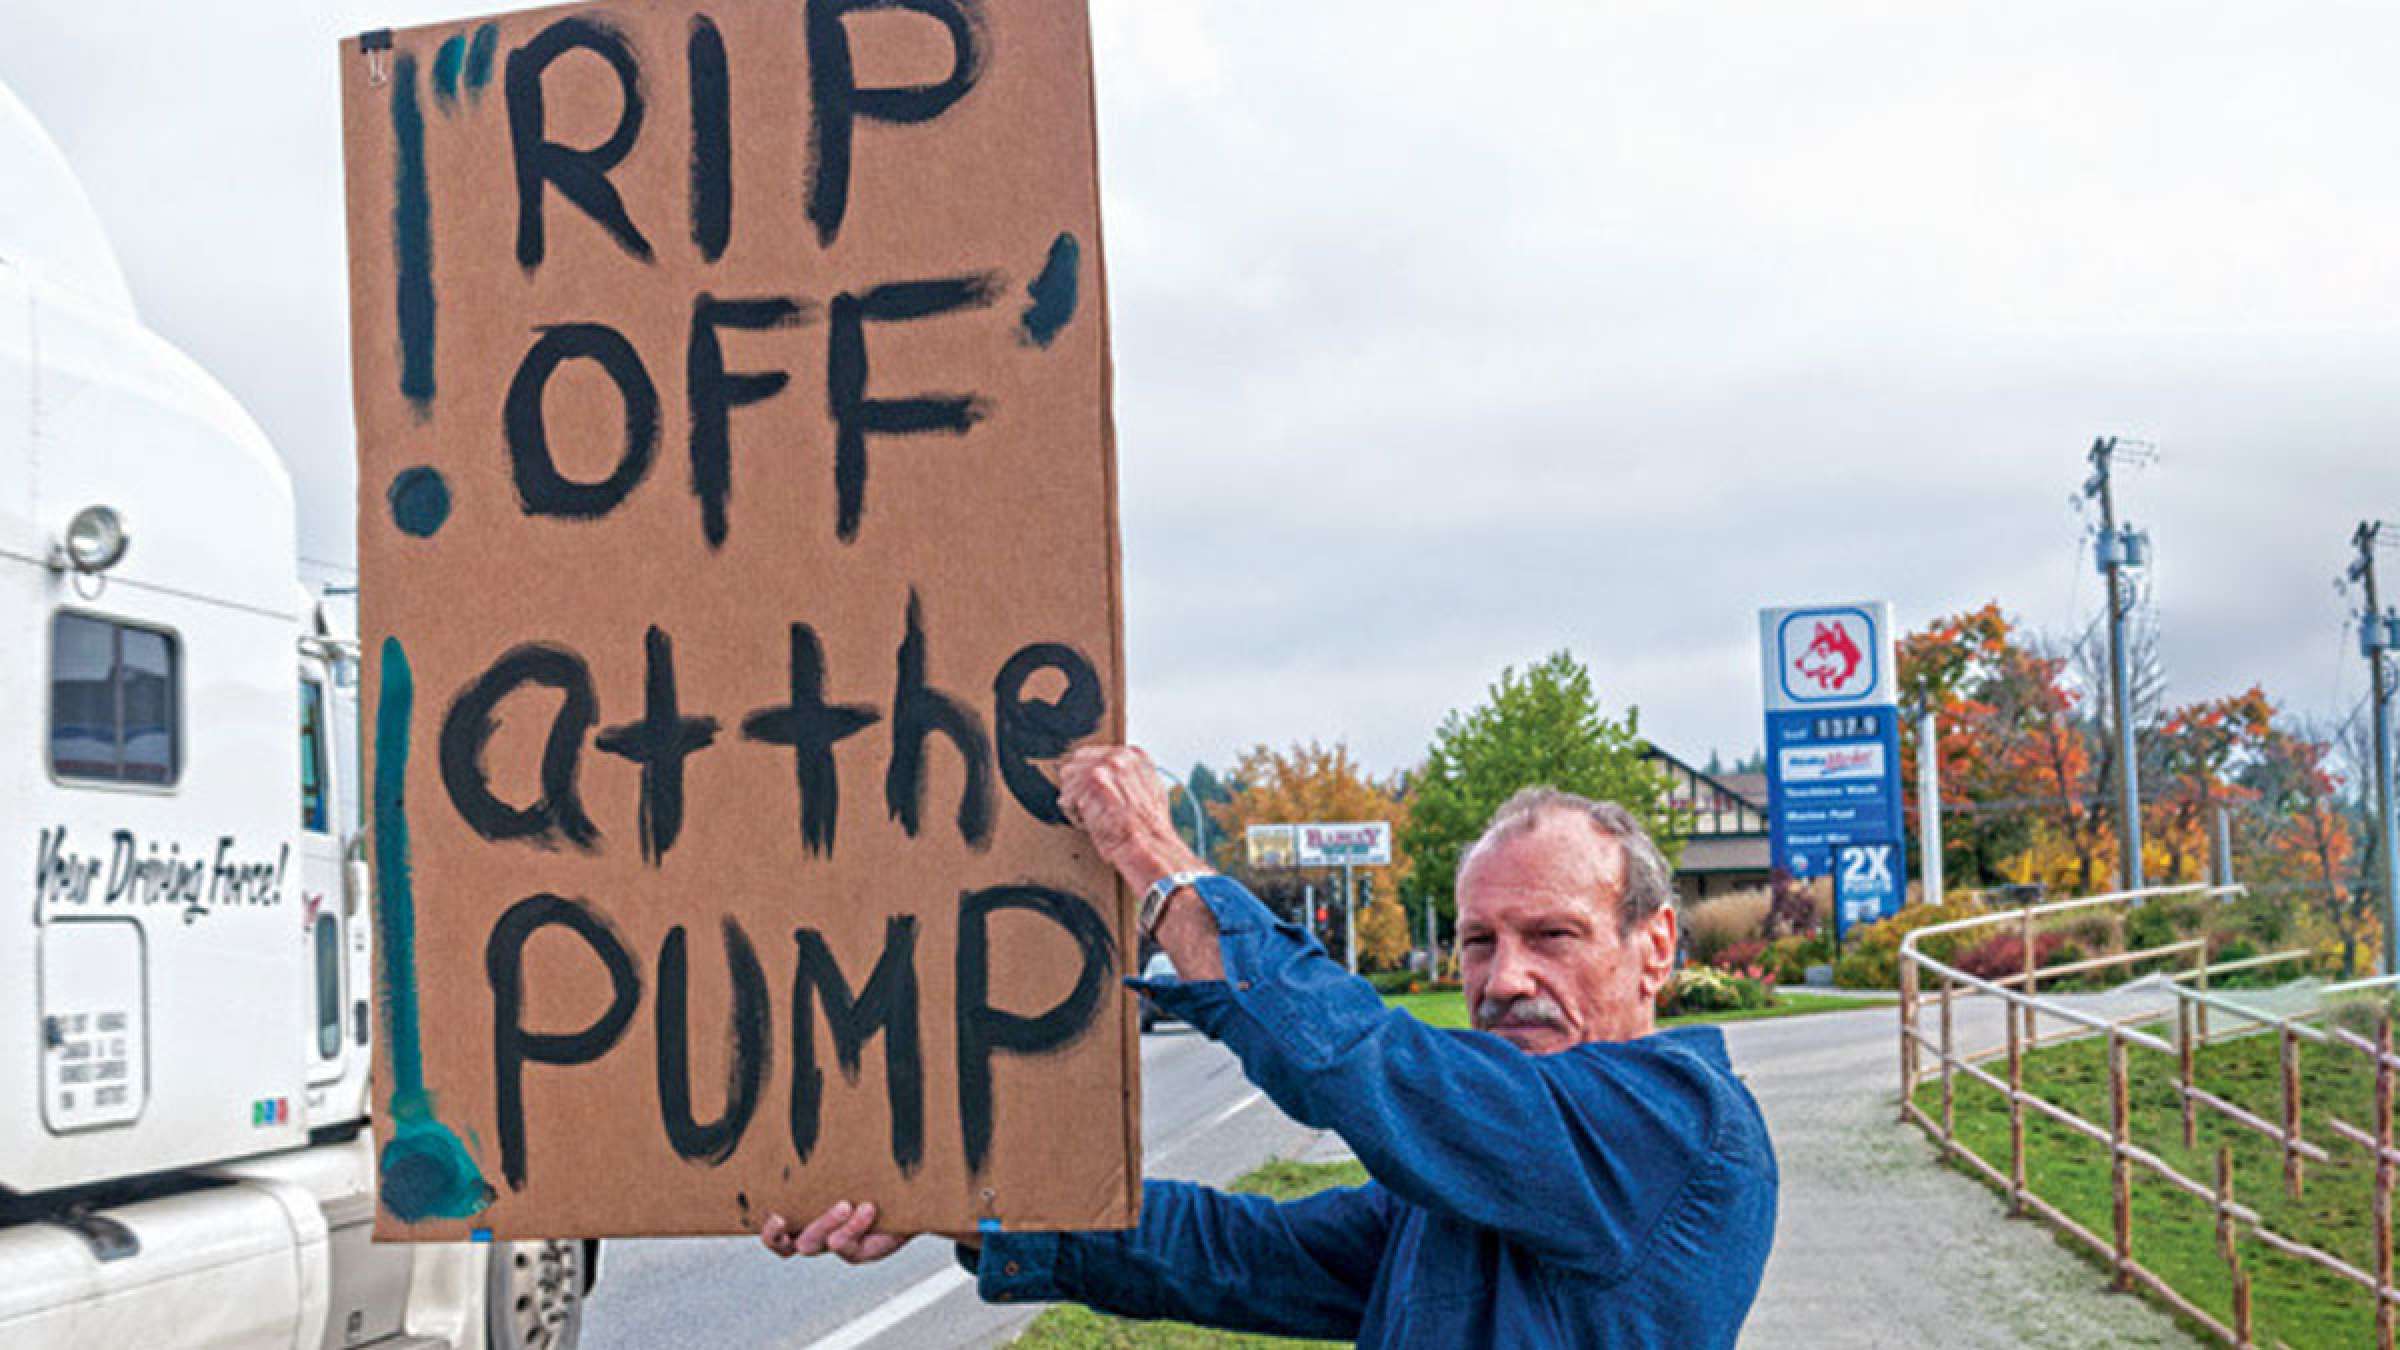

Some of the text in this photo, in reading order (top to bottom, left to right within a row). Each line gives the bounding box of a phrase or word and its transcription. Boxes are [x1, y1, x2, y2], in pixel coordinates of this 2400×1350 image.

[438, 585, 1105, 868] at the
[33, 825, 102, 928] Your
[103, 828, 210, 926] Driving
[1841, 846, 1892, 881] 2X
[486, 876, 1119, 1192] PUMP
